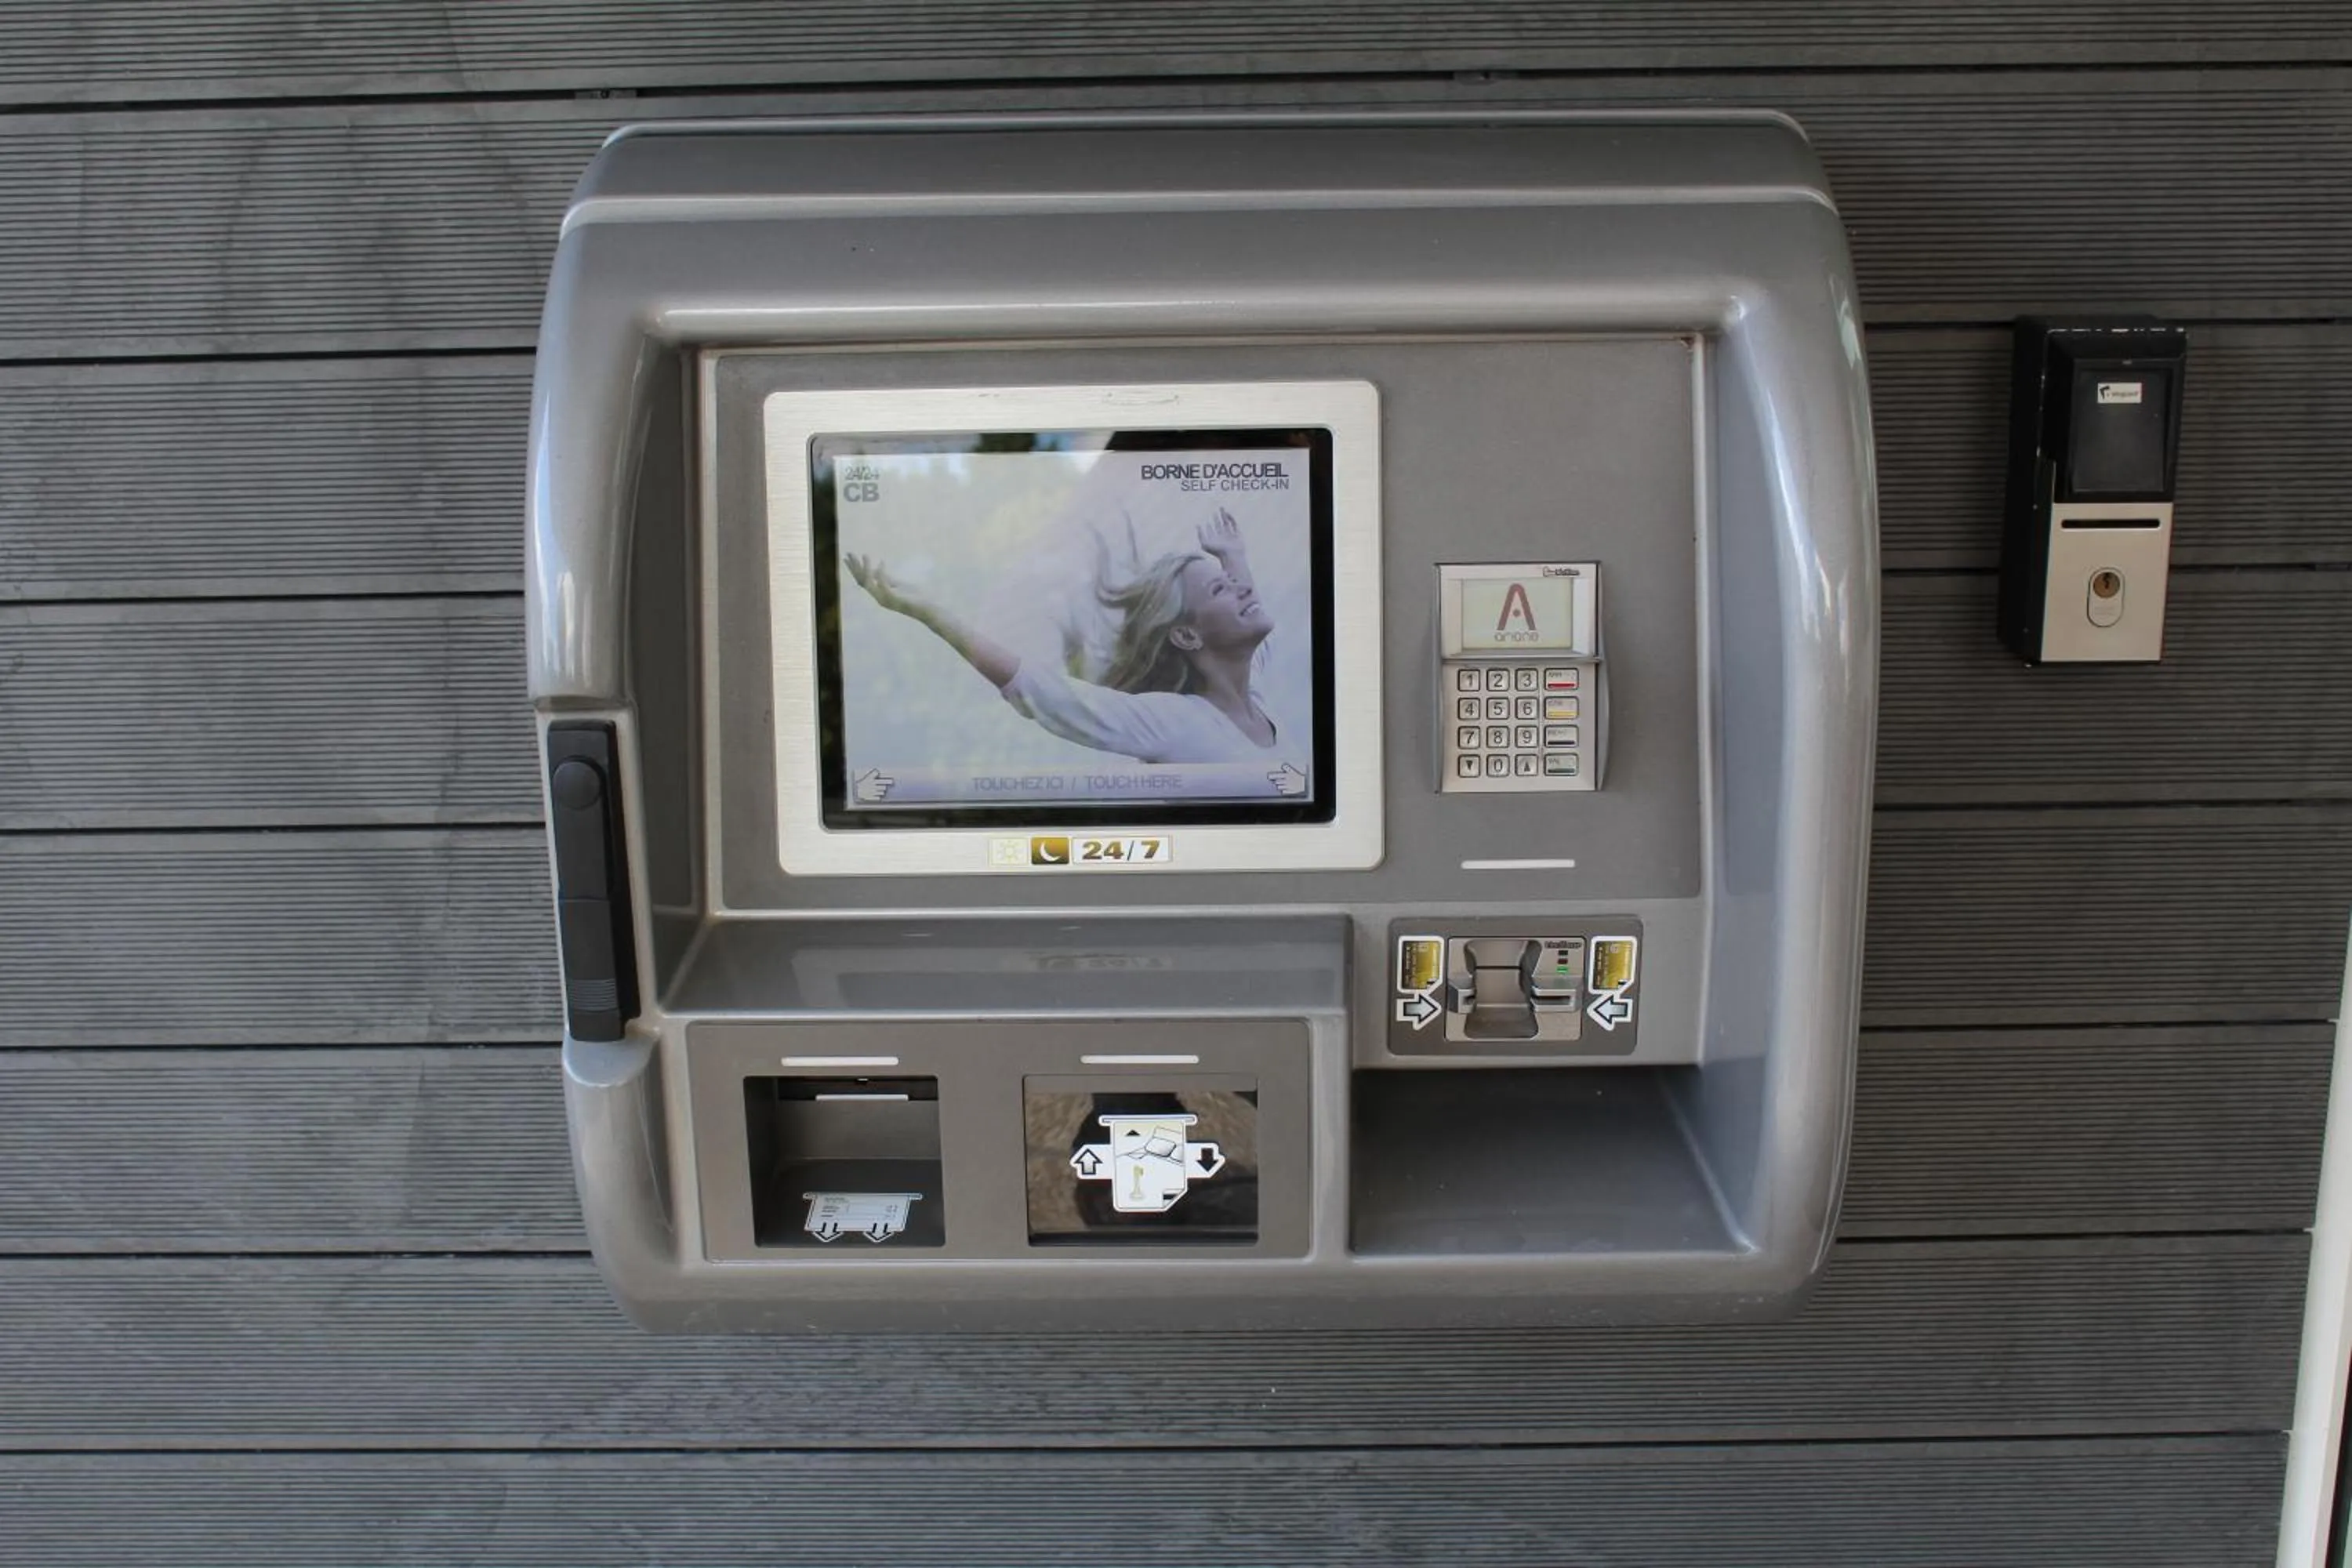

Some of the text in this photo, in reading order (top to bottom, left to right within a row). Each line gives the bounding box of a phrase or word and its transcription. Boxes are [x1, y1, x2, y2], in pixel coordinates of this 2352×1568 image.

[1142, 463, 1289, 480] BORNE D'ACCUEIL
[844, 482, 880, 503] CB
[1181, 479, 1290, 492] SELF CHECK-IN
[1494, 673, 1503, 688] 2
[1523, 673, 1533, 687] 3
[1465, 702, 1474, 716] 4
[1494, 702, 1503, 715] 5
[1523, 702, 1533, 715] 6
[1465, 731, 1475, 744] 7
[1494, 730, 1503, 744] 8
[1523, 730, 1532, 744] 9
[1494, 758, 1503, 771] 0
[971, 777, 1043, 791] TOUCHEZ
[1085, 775, 1138, 790] TOUCH
[1141, 775, 1182, 789] HERE
[1082, 840, 1160, 860] 24/7
